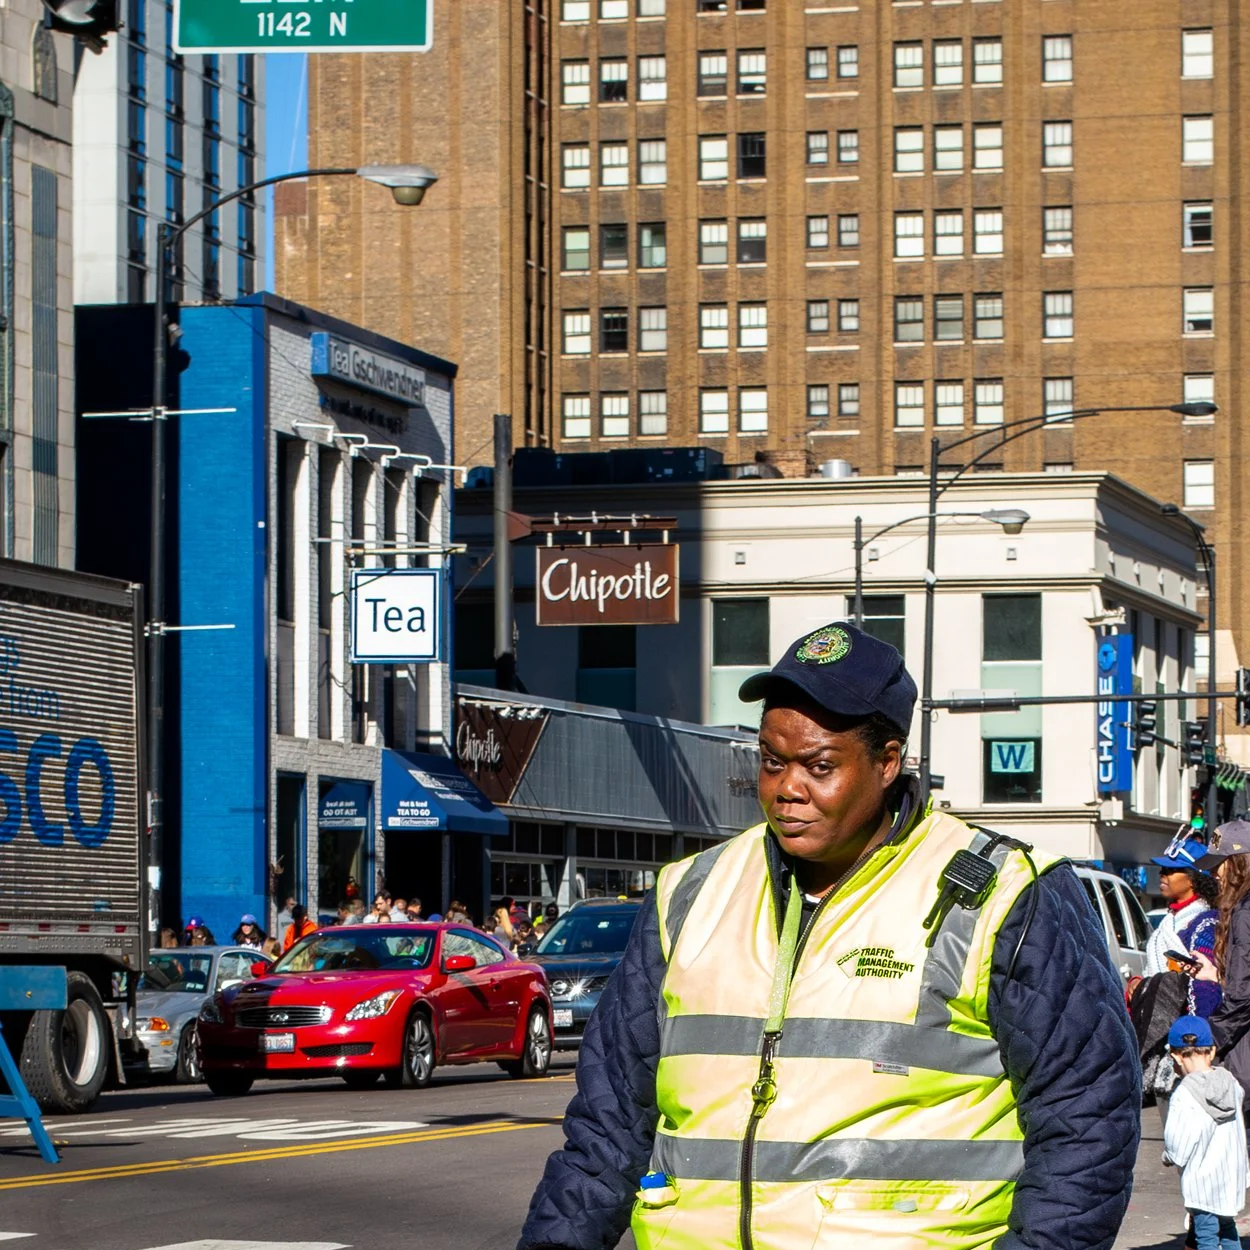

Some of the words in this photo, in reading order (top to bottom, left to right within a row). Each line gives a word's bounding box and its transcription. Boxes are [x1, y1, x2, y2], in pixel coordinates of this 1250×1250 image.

[257, 12, 311, 37] 1142
[330, 12, 347, 36] N
[330, 341, 349, 375] Tea
[542, 558, 671, 613] Chipotle
[365, 598, 425, 632] Tea
[1099, 676, 1114, 783] CHASE
[456, 721, 500, 772] Chipotle
[997, 744, 1026, 769] W
[857, 958, 915, 972] MANAGEMENT
[861, 948, 894, 959] TRAFFIC
[855, 968, 904, 979] AUTHORITY
